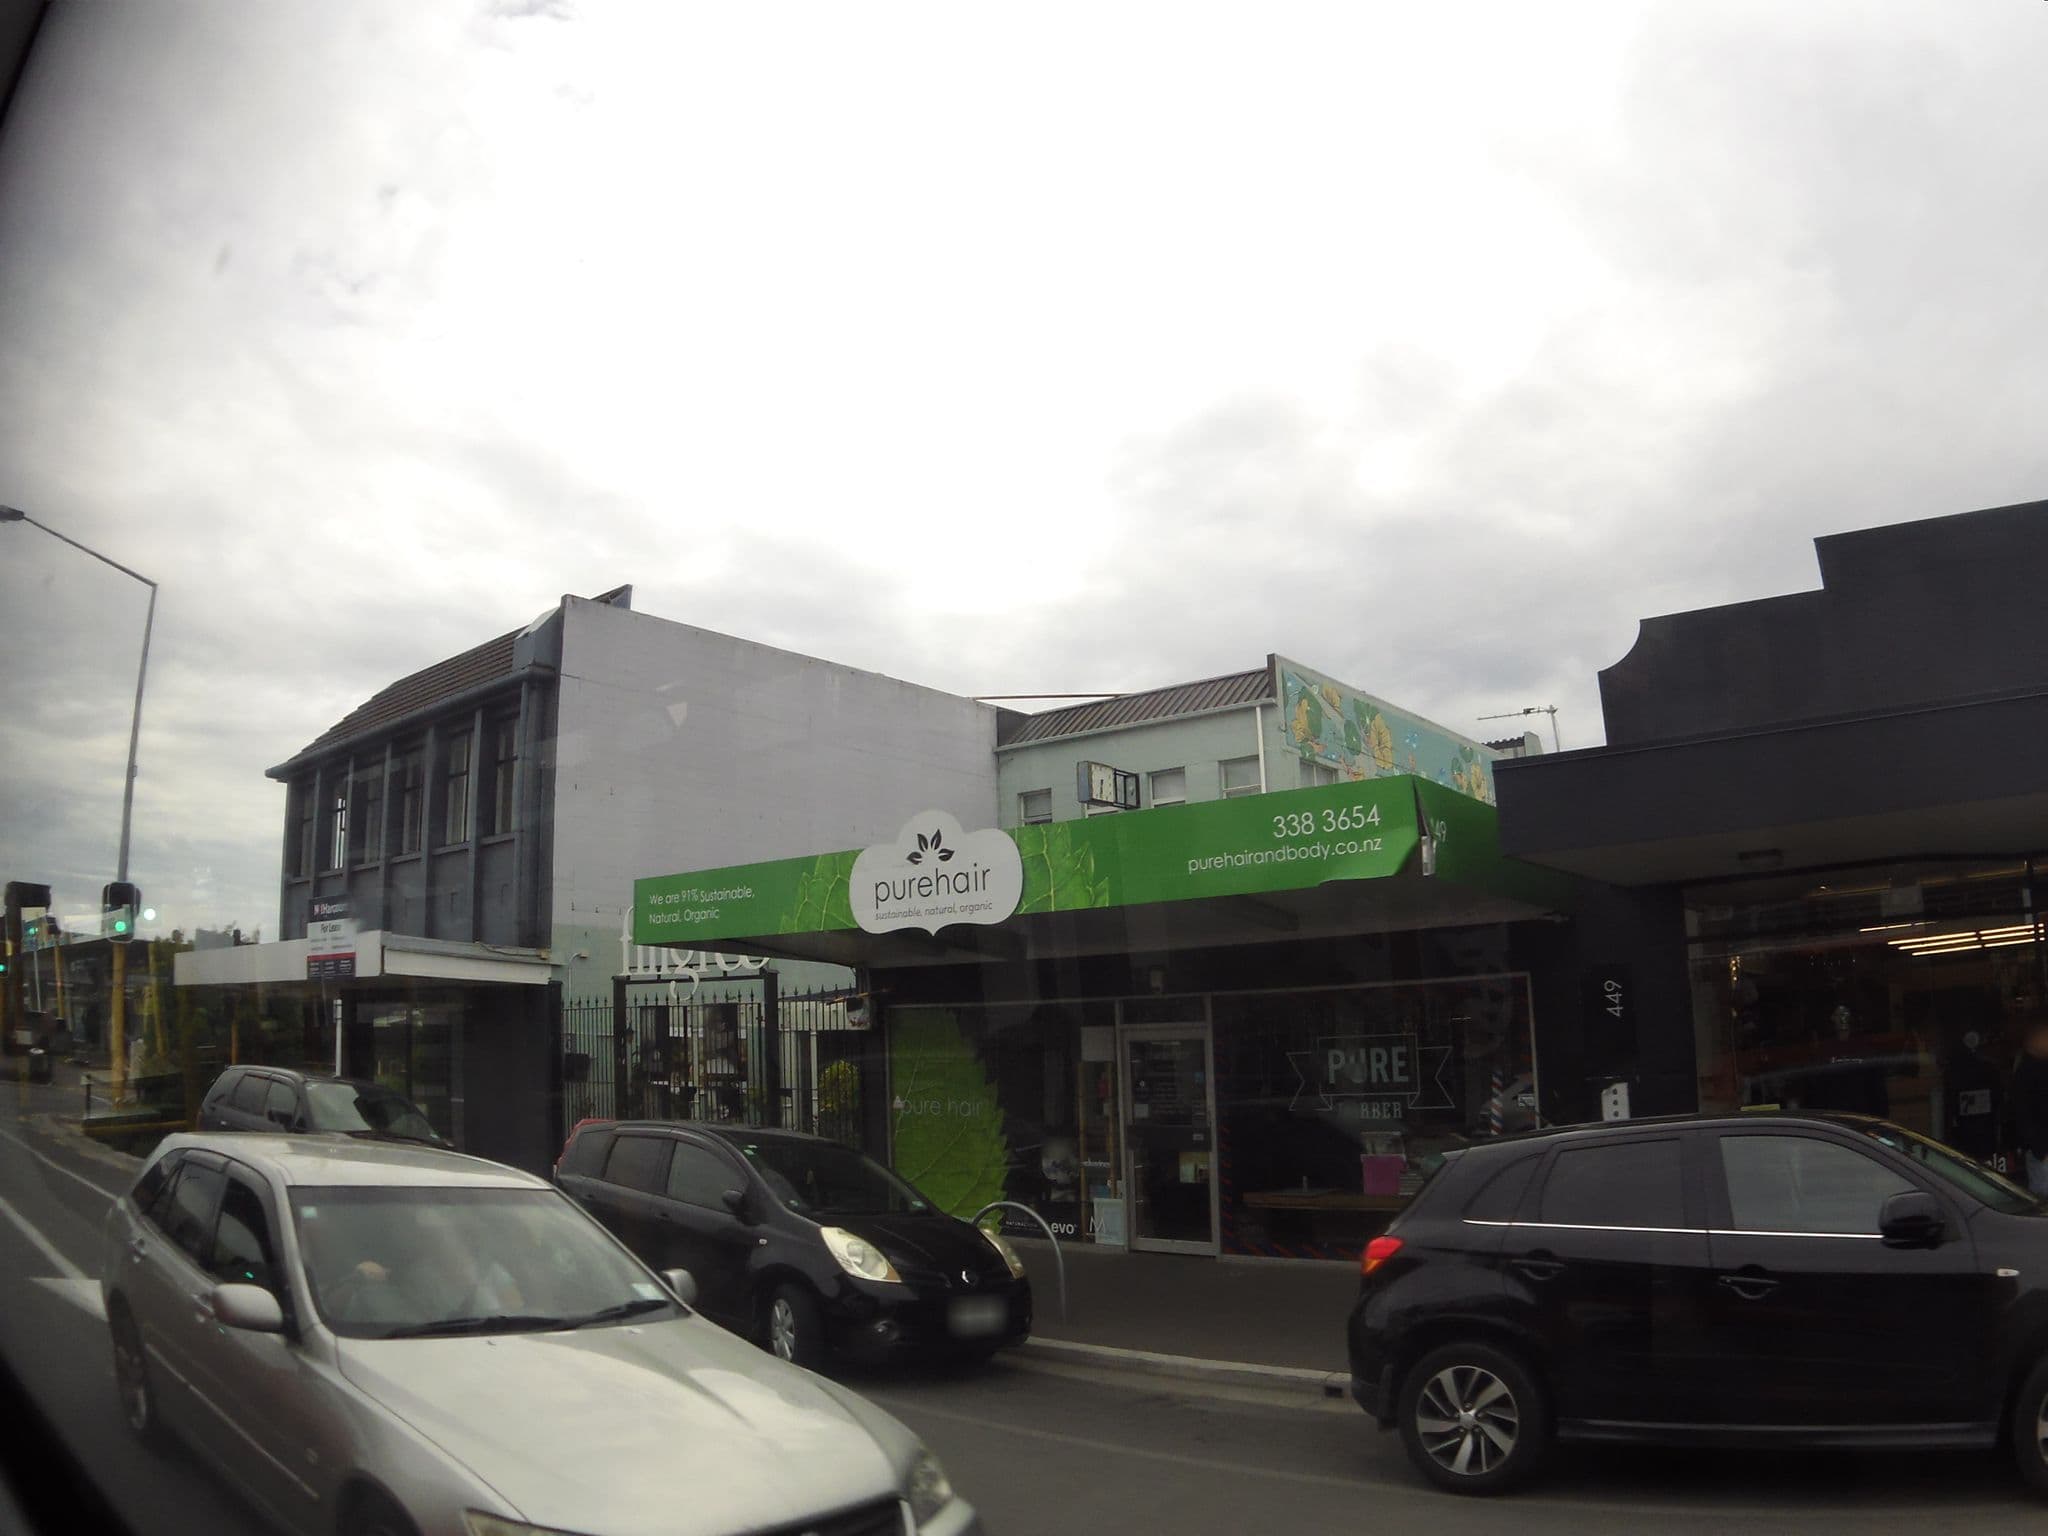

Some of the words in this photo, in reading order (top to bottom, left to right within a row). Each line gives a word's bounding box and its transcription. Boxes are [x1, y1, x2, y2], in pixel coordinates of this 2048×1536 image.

[1273, 812, 1314, 838] 338
[1322, 804, 1381, 832] 3654
[1188, 837, 1382, 875] purehairandbody.co.nz
[649, 893, 663, 904] We
[665, 893, 680, 904] are
[681, 889, 699, 902] 91%
[875, 863, 990, 909] purehair
[684, 907, 720, 923] Organic
[960, 900, 993, 914] organic
[1603, 980, 1624, 1018] 449
[1328, 1046, 1409, 1084] PURE
[1051, 1222, 1076, 1235] evo
